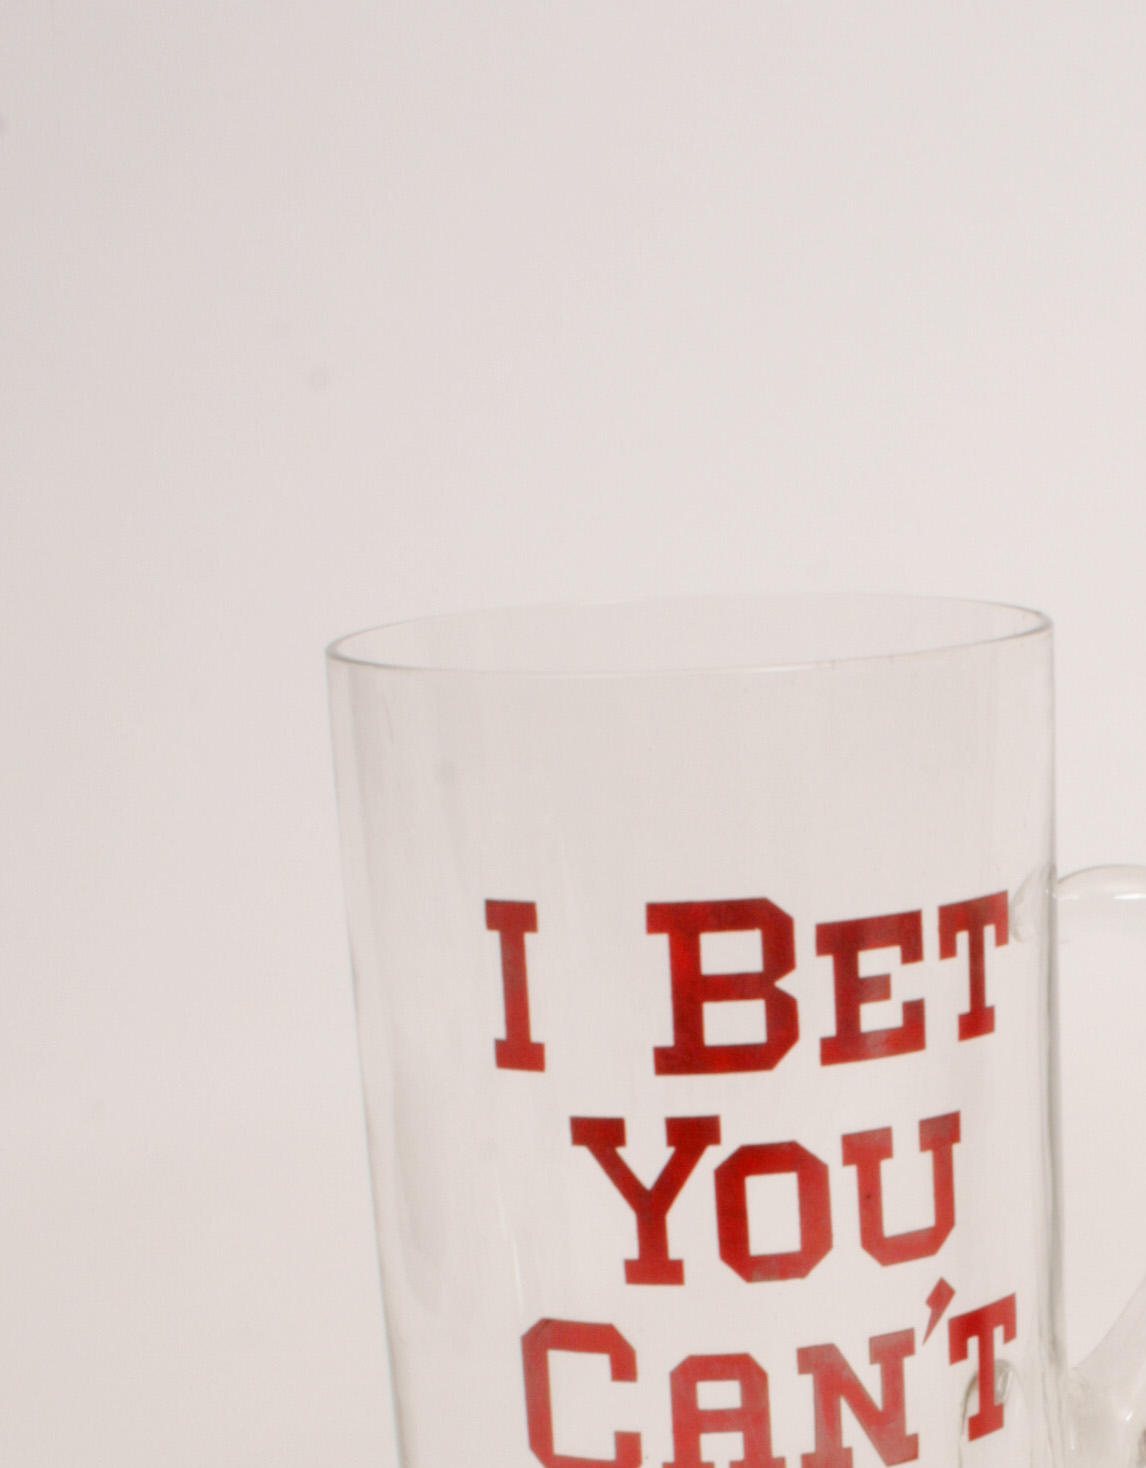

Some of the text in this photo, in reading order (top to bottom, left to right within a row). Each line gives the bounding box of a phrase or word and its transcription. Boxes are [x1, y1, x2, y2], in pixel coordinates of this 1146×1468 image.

[485, 890, 1009, 1076] I BET
[570, 1111, 962, 1286] YOU
